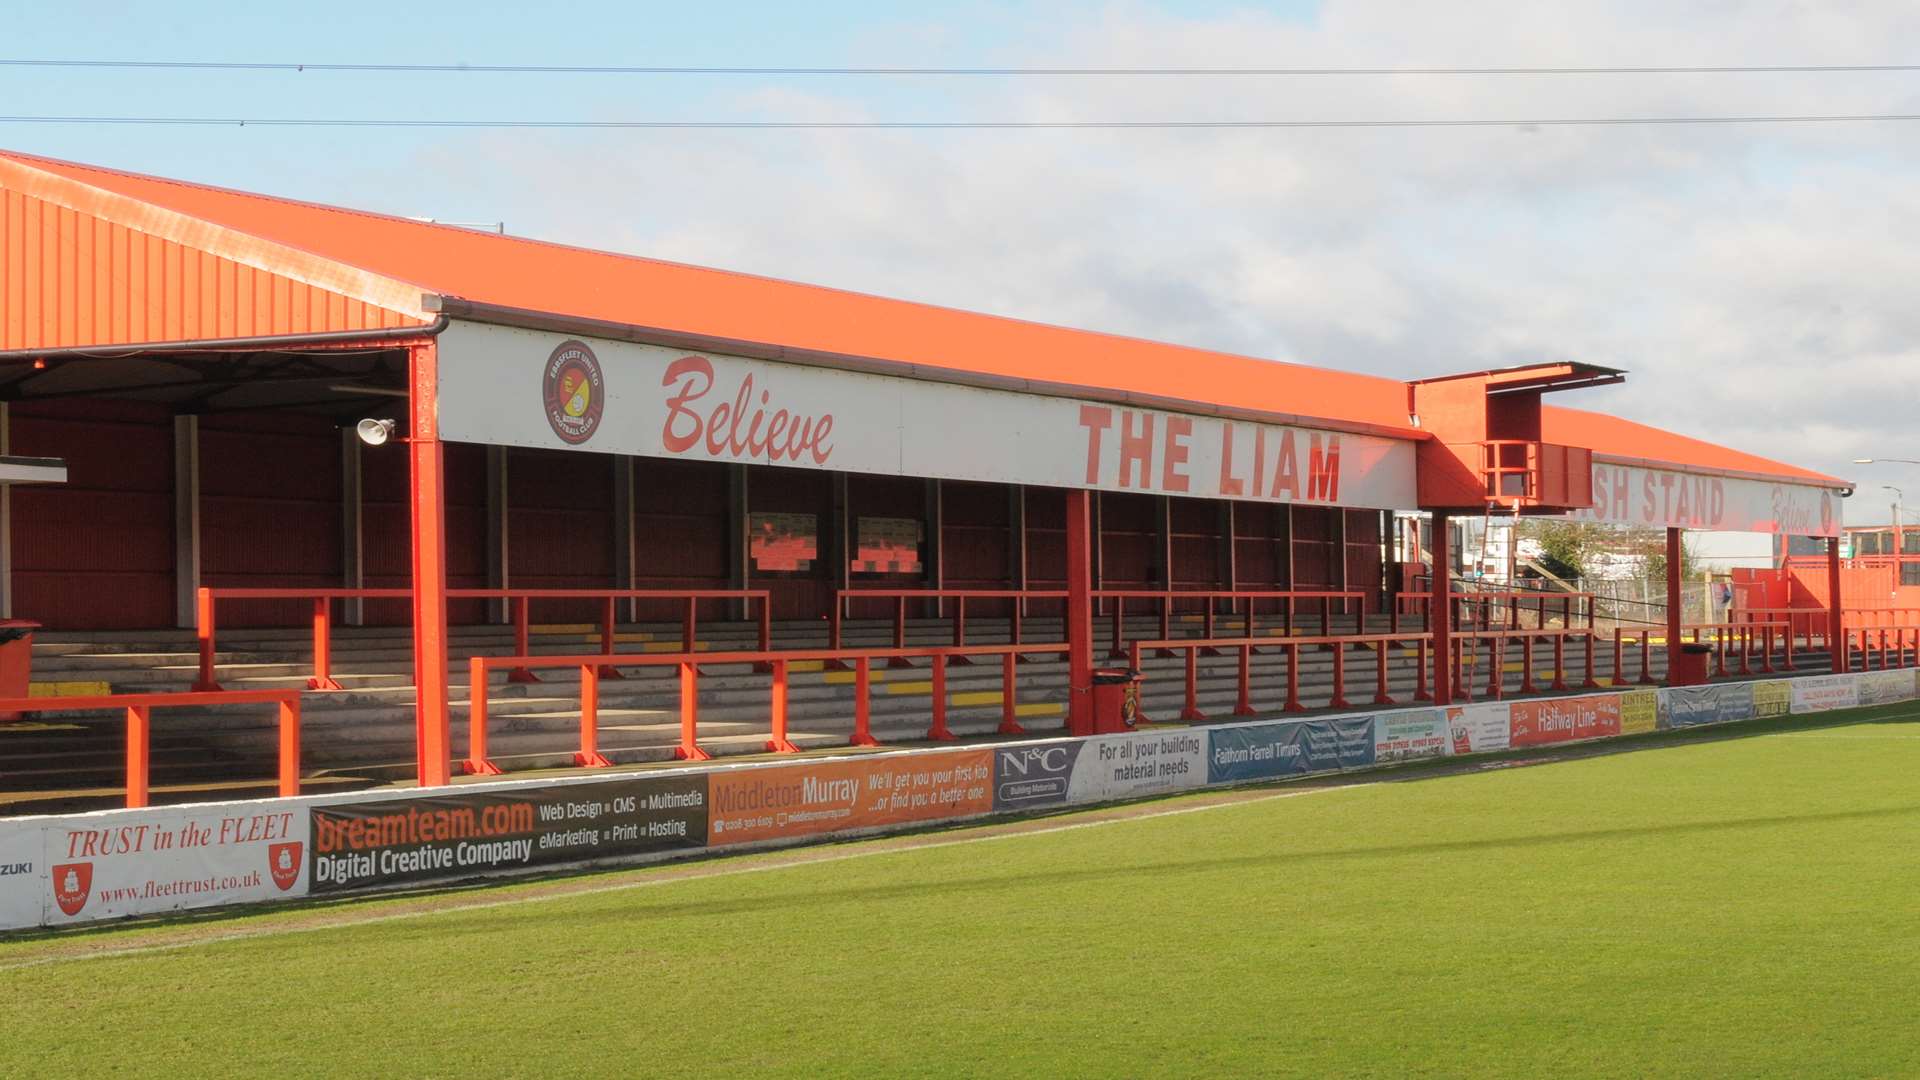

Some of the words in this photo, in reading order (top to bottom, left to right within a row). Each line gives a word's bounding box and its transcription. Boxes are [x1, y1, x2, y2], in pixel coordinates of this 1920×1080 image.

[662, 356, 833, 464] Believe
[1080, 404, 1193, 492] THE
[1219, 423, 1341, 503] LIAM
[1582, 466, 1630, 520] SH
[1643, 471, 1724, 526] STAND
[1538, 706, 1576, 736] Halfway
[1577, 704, 1596, 727] Line
[1000, 747, 1067, 776] N&C
[1099, 743, 1117, 760] For
[1120, 741, 1132, 758] all
[1135, 743, 1158, 760] your
[1161, 736, 1200, 754] building
[869, 771, 892, 789] We'll
[895, 772, 910, 791] get
[913, 773, 929, 789] you
[932, 770, 952, 787] your
[954, 765, 972, 784] first
[974, 764, 988, 783] job
[1114, 760, 1156, 781] material
[1160, 757, 1189, 776] needs
[540, 805, 564, 821] Web
[567, 801, 602, 819] Design
[613, 797, 635, 814] CMS
[649, 790, 703, 810] Multimedia
[890, 792, 908, 812] find
[911, 793, 928, 809] you
[930, 792, 936, 804] a
[940, 788, 966, 803] better
[968, 787, 984, 799] one
[67, 825, 149, 858] TRUST
[154, 824, 172, 850] in
[180, 822, 212, 849] the
[218, 813, 294, 844] FLEET
[317, 802, 533, 852] breamteam.com
[539, 828, 599, 849] eMarketing
[613, 824, 638, 841] Print
[649, 820, 686, 837] Hosting
[316, 851, 376, 884] Digital
[380, 844, 452, 874] Creative
[457, 838, 533, 865] Company
[100, 870, 261, 903] www.fleettrust.co.uk
